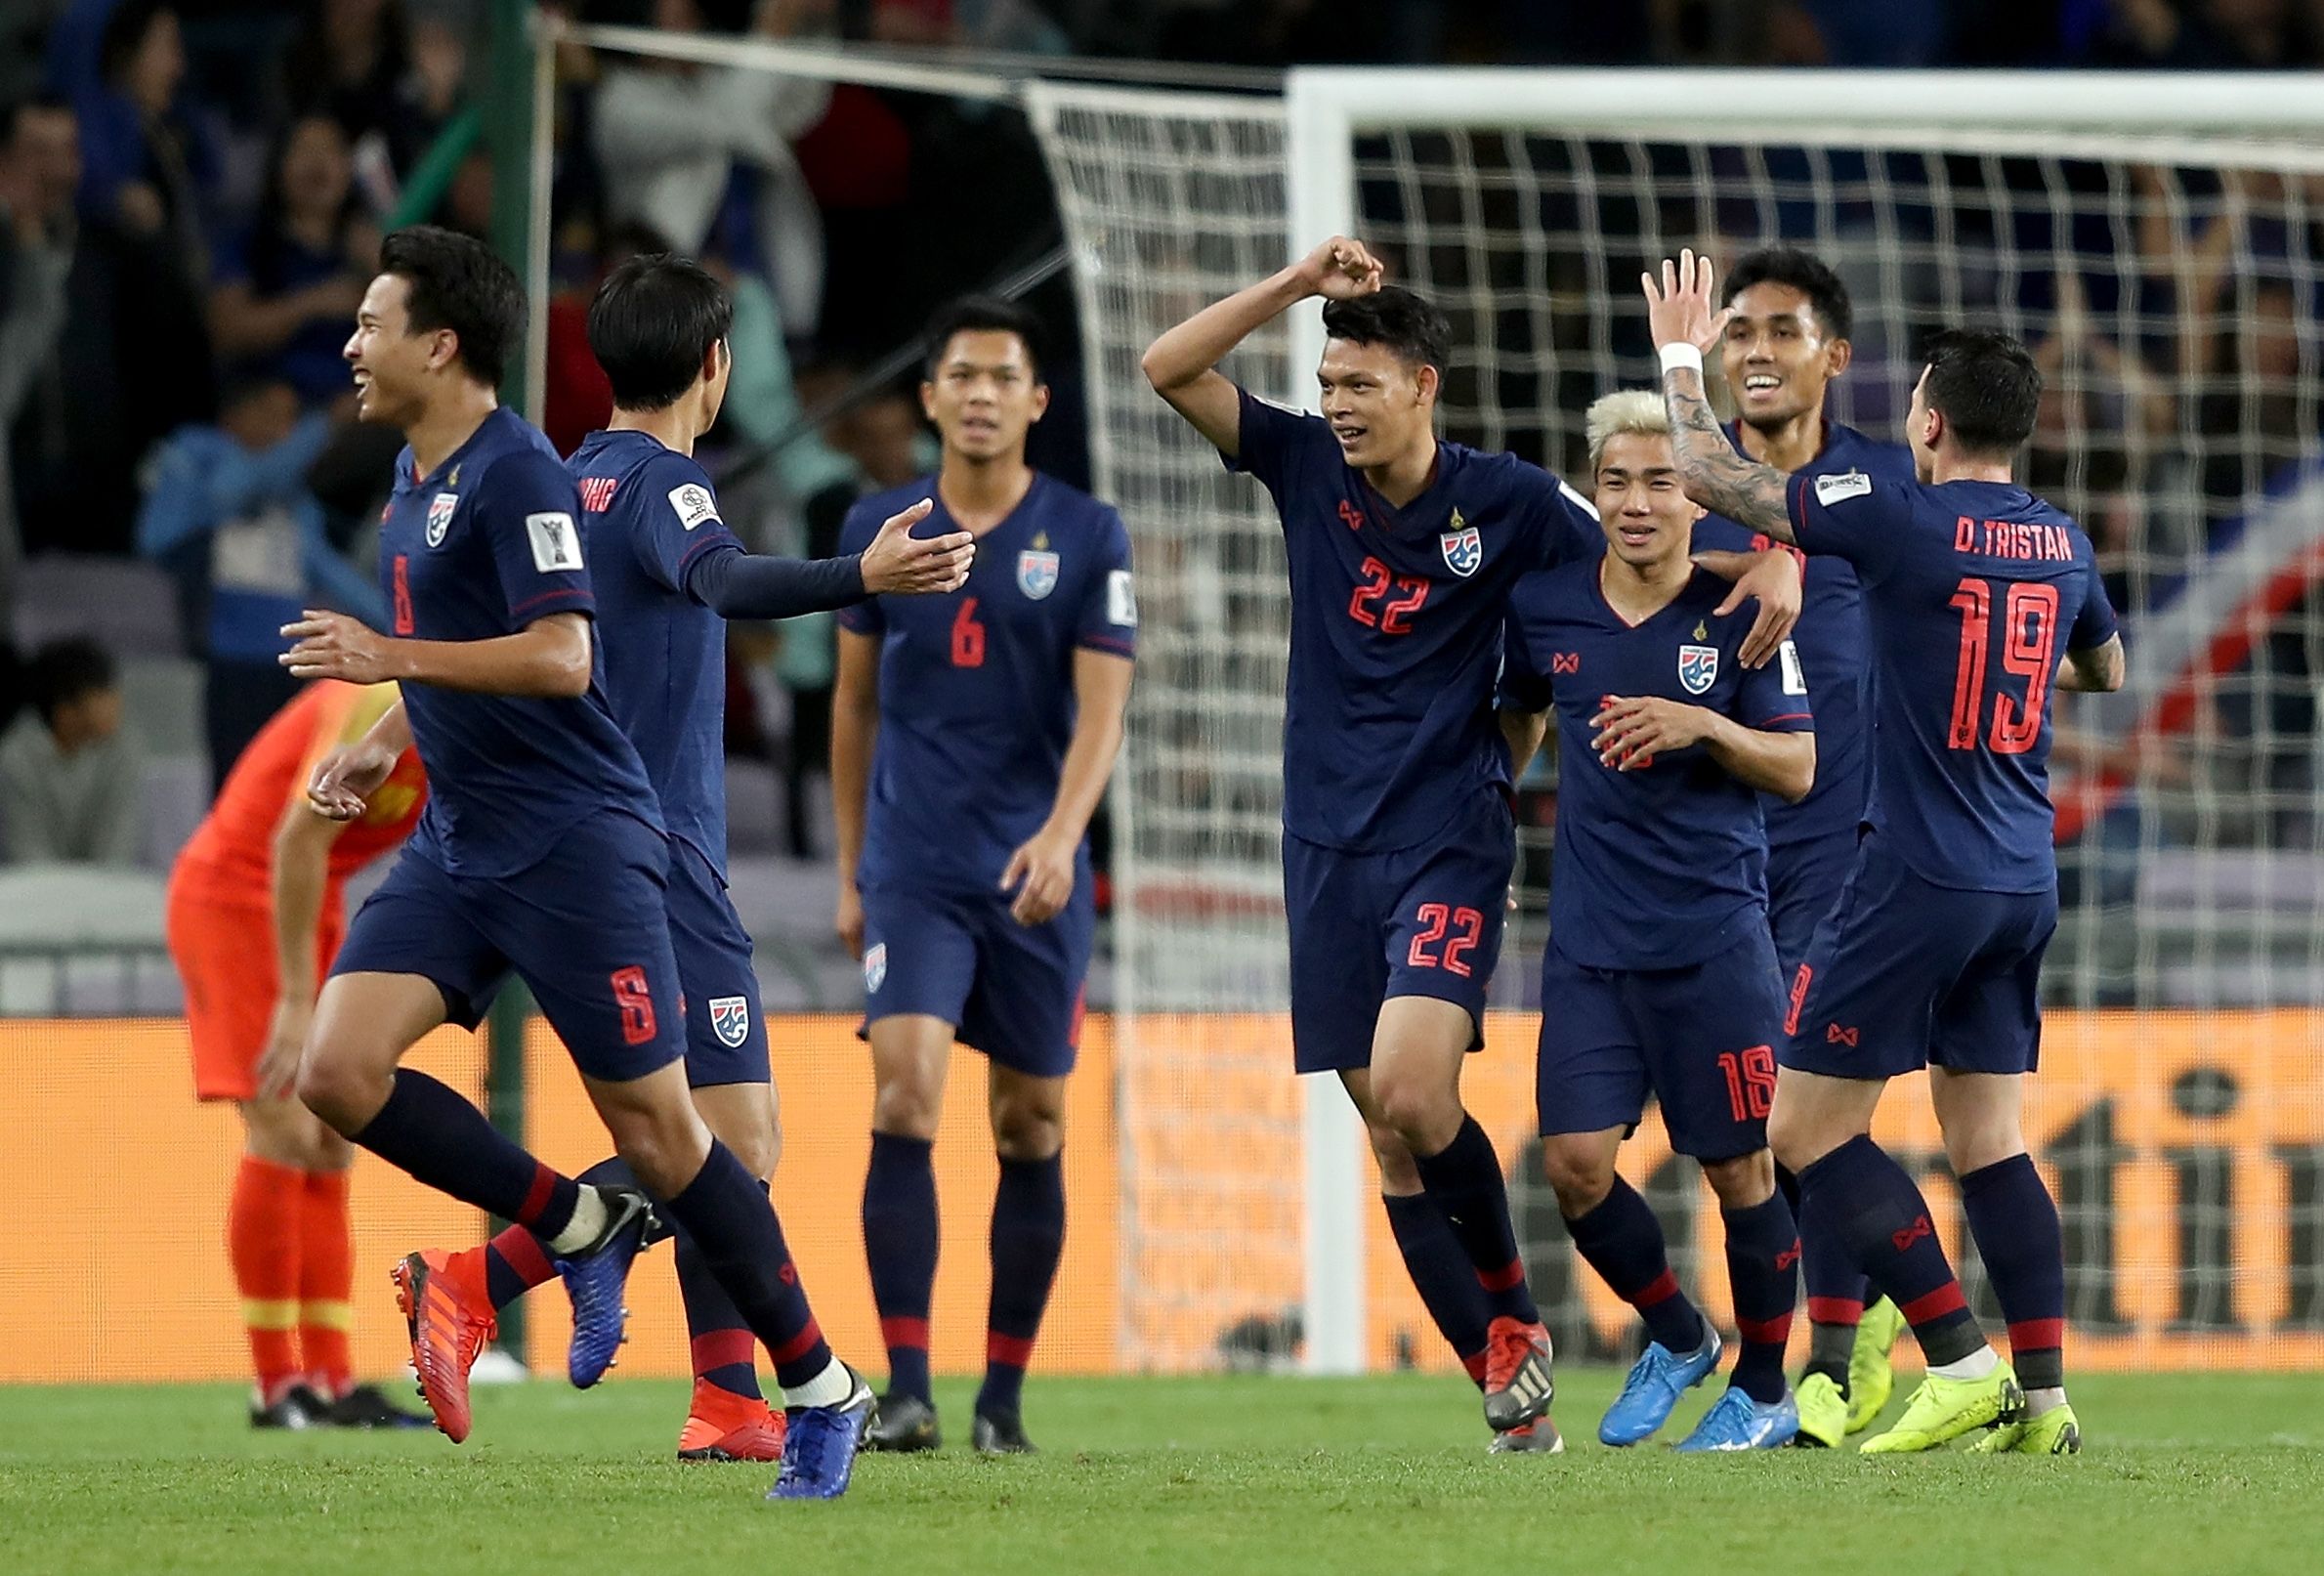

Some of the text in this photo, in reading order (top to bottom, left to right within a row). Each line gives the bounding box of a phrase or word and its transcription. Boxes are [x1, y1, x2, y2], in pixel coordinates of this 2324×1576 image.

[1955, 516, 2073, 561] D.TRISTAN
[951, 597, 986, 667] 6
[1348, 556, 1430, 634] 22
[1948, 577, 2059, 754] 19
[1408, 903, 1484, 977] 22
[611, 965, 657, 1045] 8
[1717, 1044, 1777, 1122] 18
